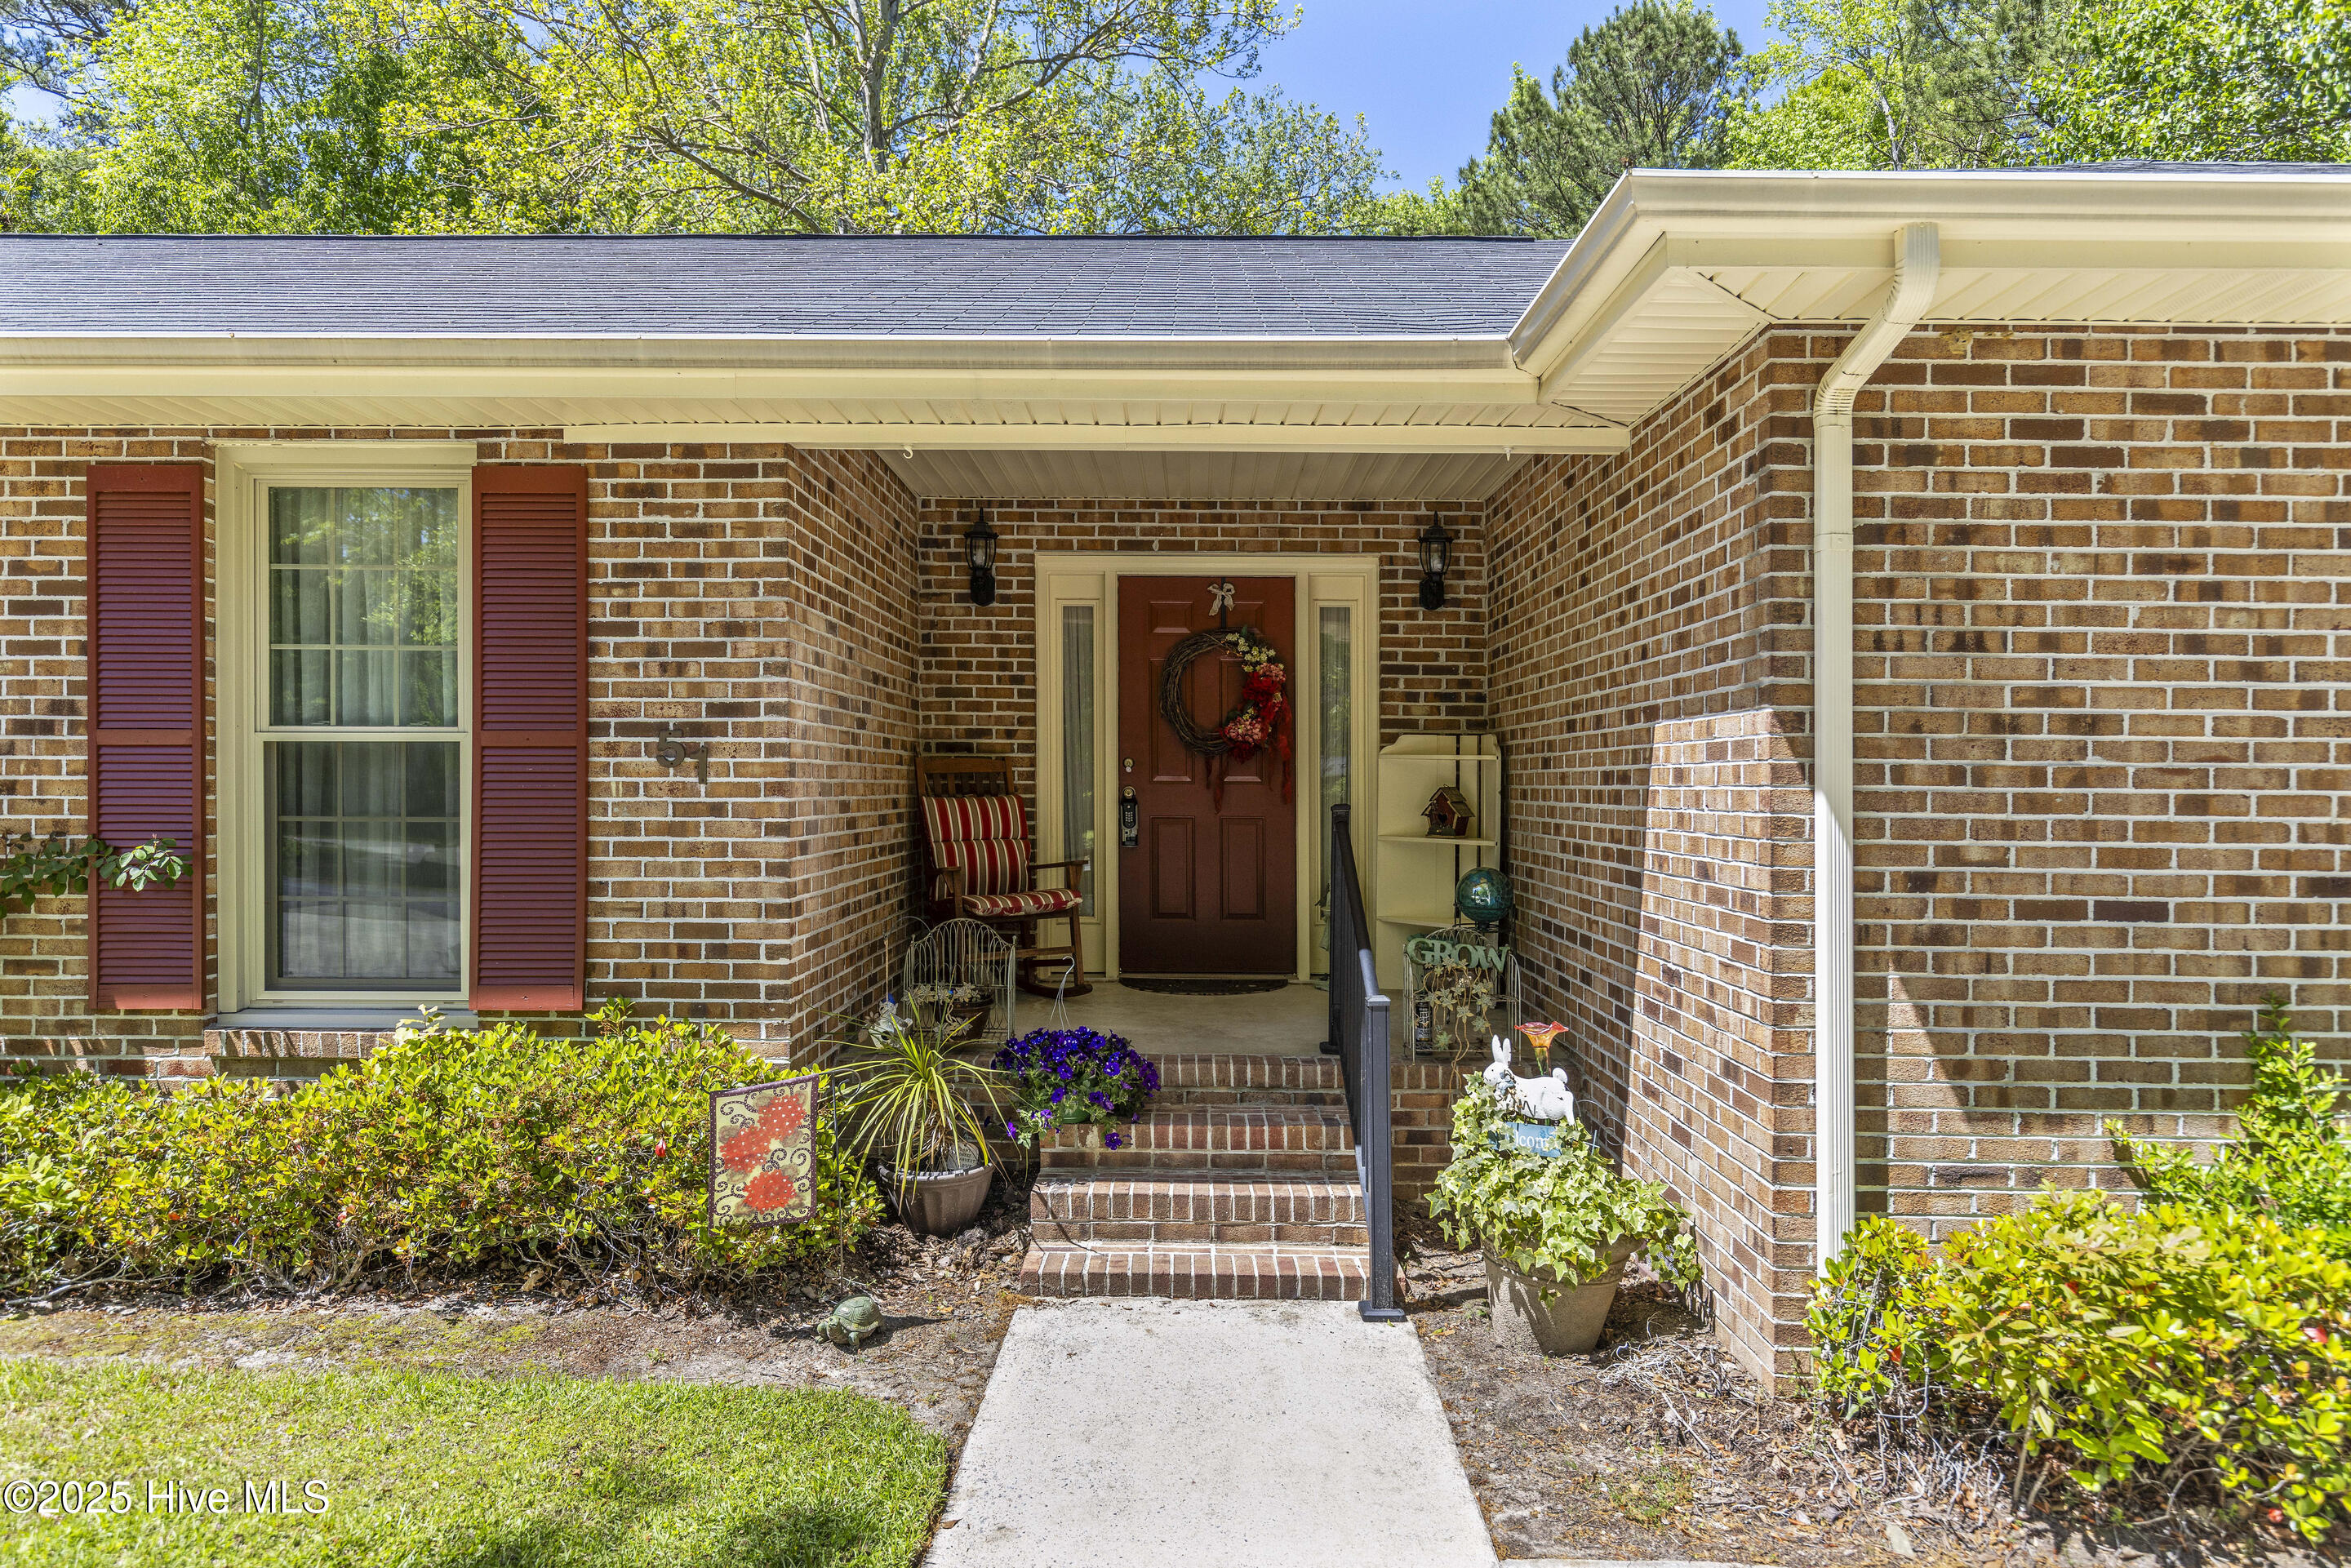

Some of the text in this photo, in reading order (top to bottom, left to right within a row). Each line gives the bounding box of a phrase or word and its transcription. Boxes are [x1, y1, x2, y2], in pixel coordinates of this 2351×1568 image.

[656, 729, 708, 784] 51
[1407, 937, 1511, 973] GROW
[1504, 1130, 1553, 1149] lcom
